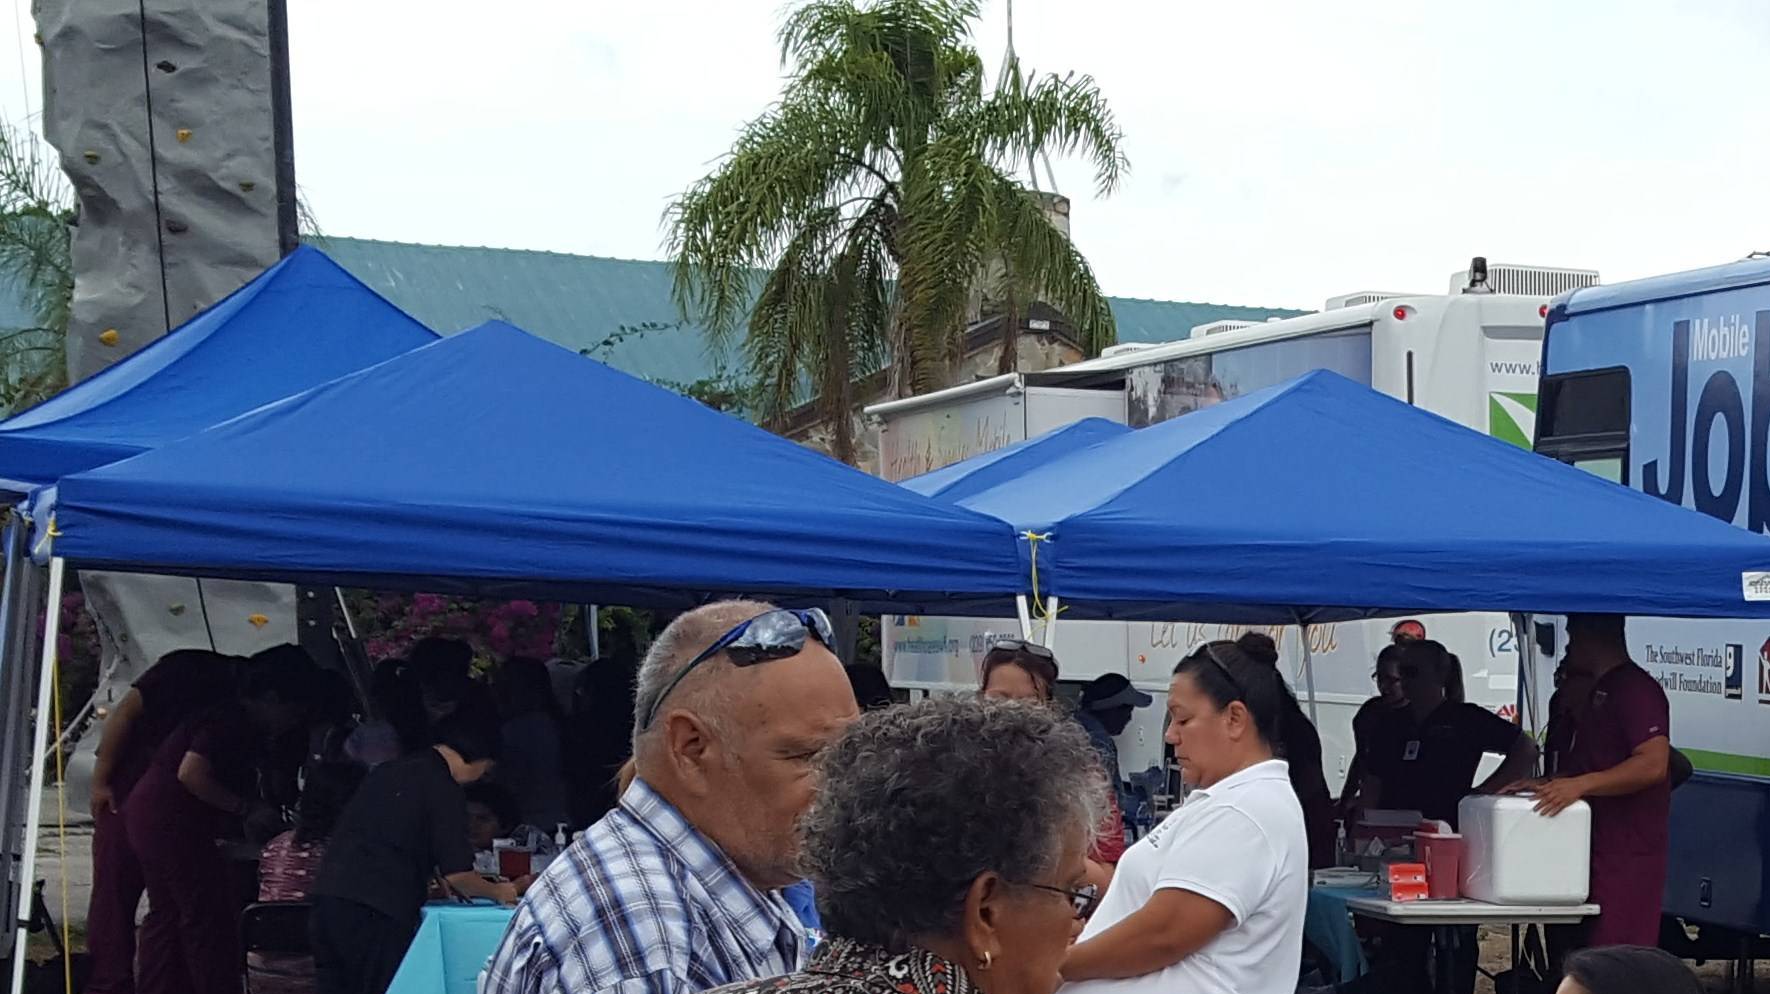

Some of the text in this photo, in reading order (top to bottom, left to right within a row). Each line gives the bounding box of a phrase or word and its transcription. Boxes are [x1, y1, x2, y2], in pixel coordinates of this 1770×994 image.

[1693, 313, 1750, 361] Mobile
[1646, 645, 1723, 668] The Southwest Florida
[1679, 673, 1723, 695] Foundation
